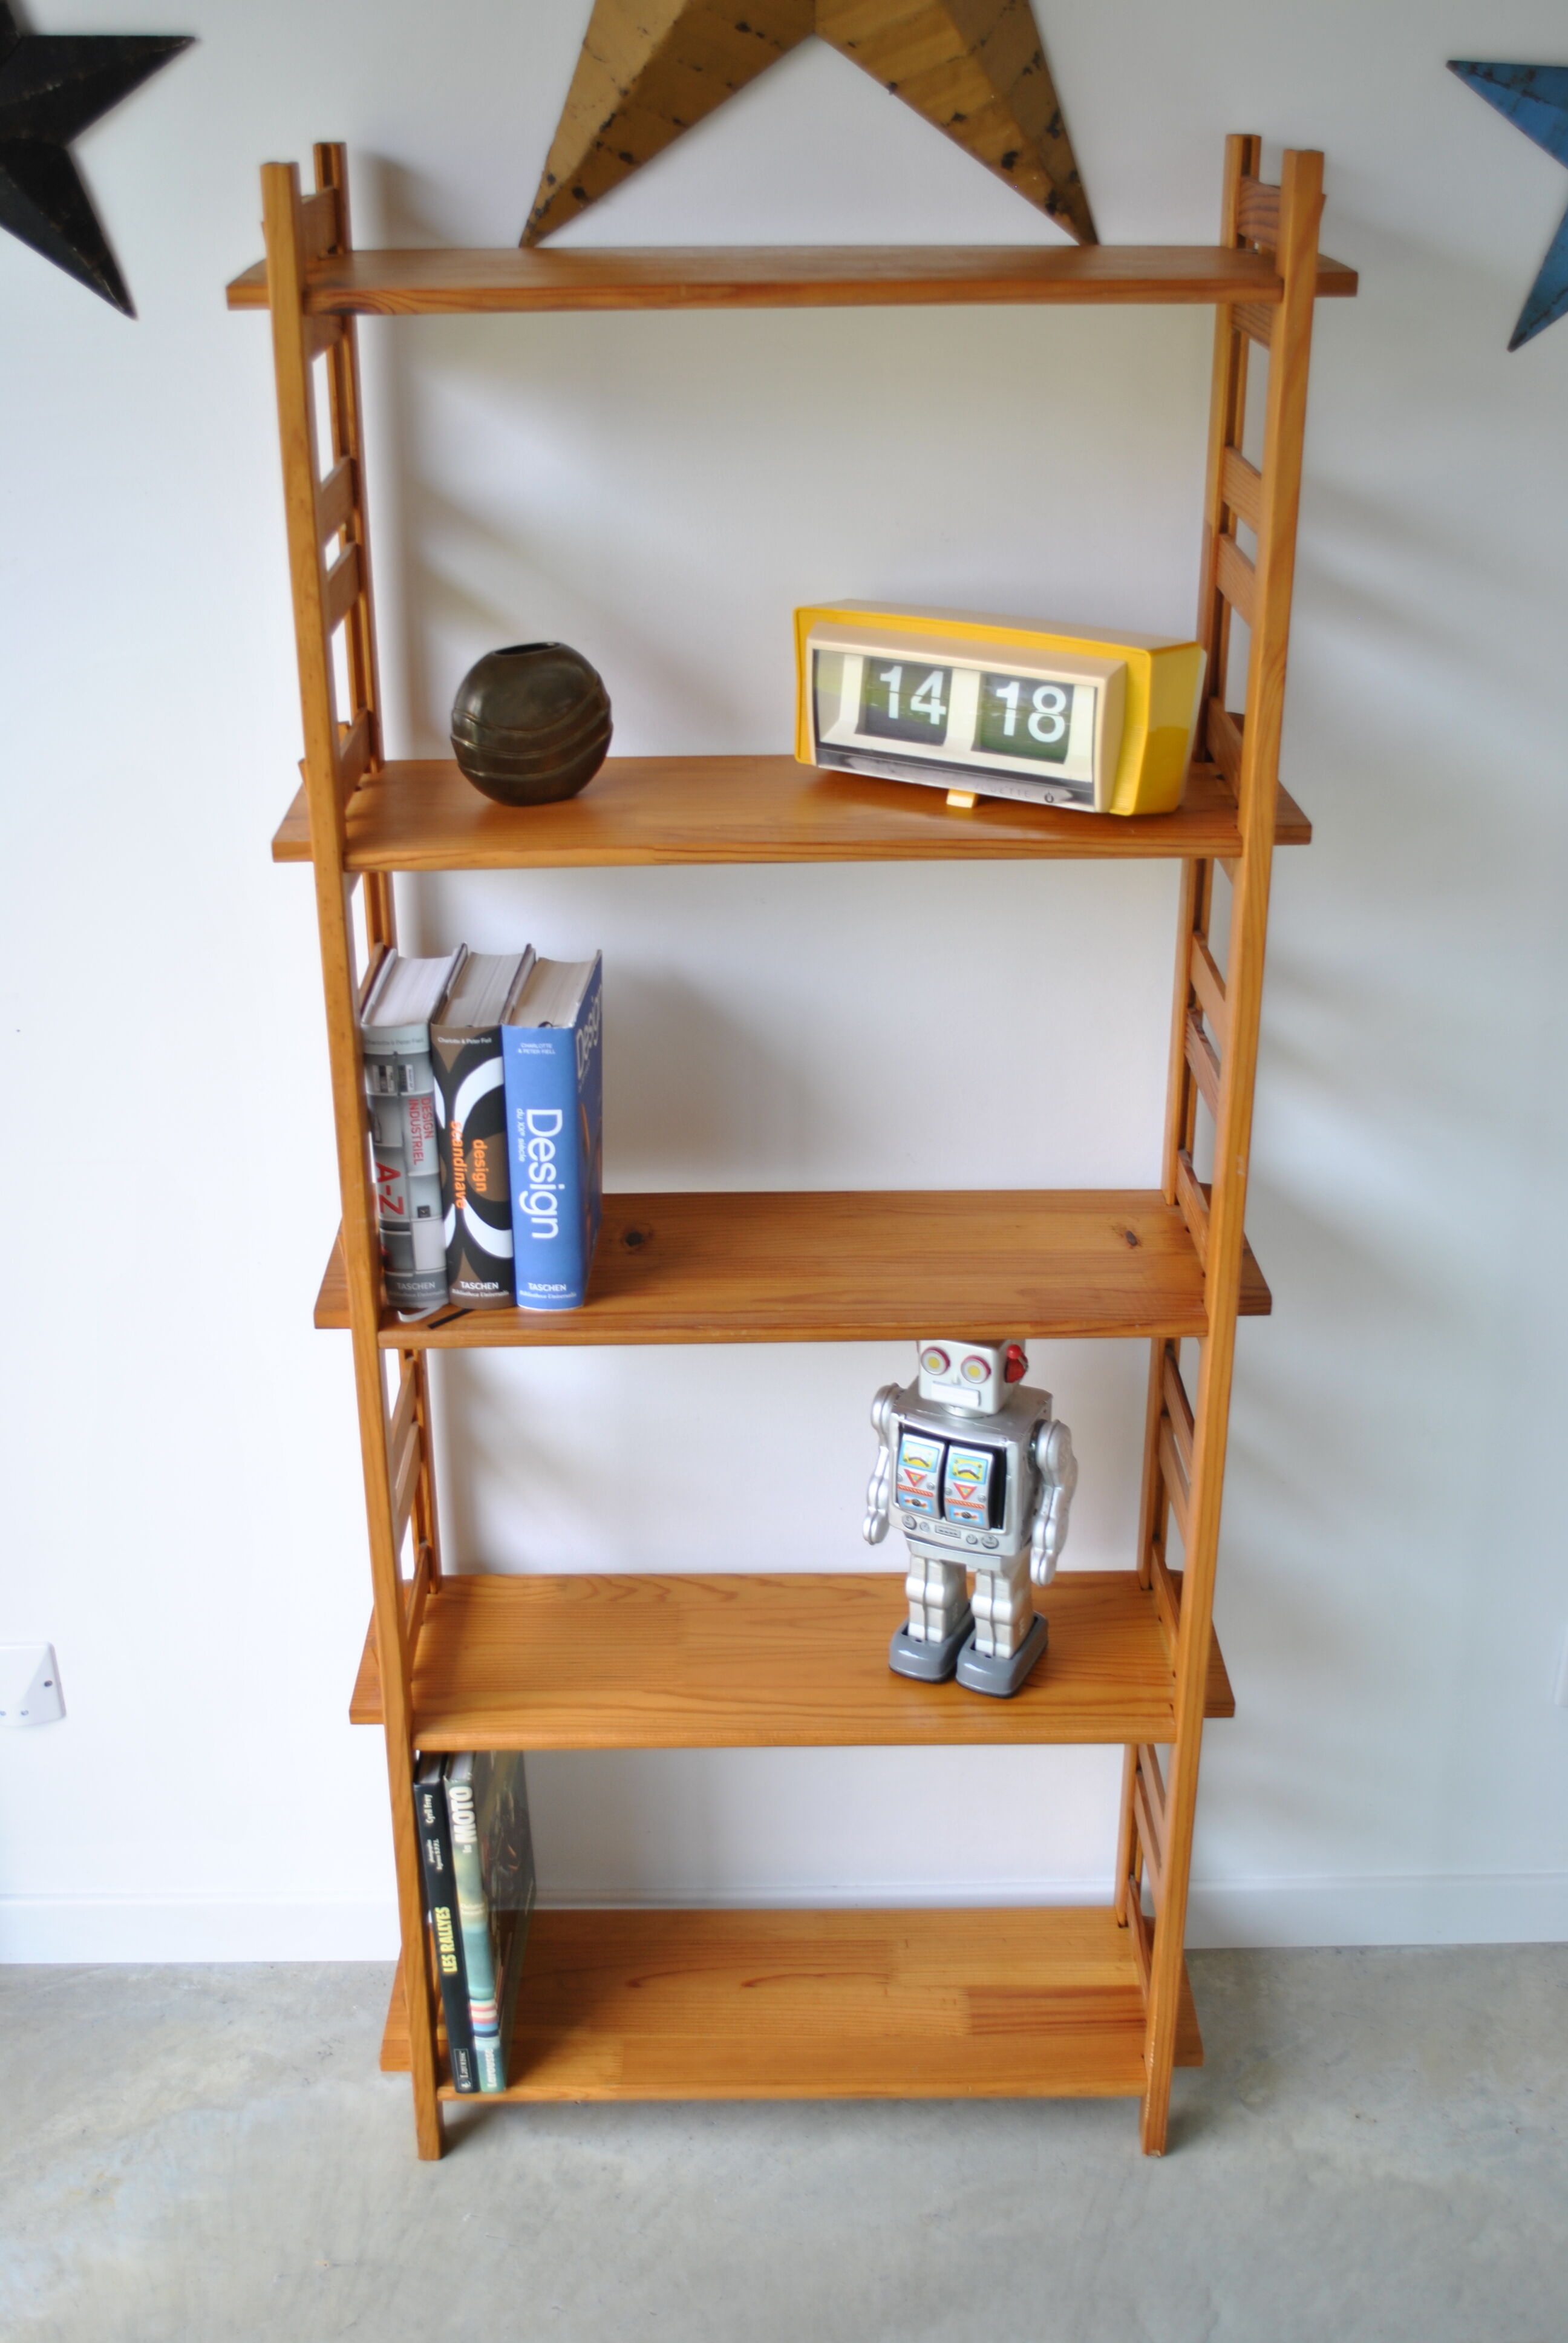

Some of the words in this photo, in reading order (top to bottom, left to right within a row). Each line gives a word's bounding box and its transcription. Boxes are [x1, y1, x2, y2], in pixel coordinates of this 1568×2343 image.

[880, 666, 946, 725] 14
[996, 681, 1067, 742] 18
[408, 1098, 425, 1165] INDUSTRIEL
[420, 1096, 434, 1140] DESIGN
[517, 1108, 525, 1119] du
[375, 1161, 404, 1215] A-Z
[450, 1119, 468, 1210] scandinave
[472, 1139, 489, 1192] design
[518, 1109, 565, 1239] Design
[397, 1281, 436, 1290] TASCHEN
[460, 1281, 499, 1290] TASCHEN
[528, 1282, 567, 1292] TASCHEN
[449, 1786, 477, 1843] MOTO
[434, 1906, 455, 1953] RALLYES
[441, 1953, 458, 1973] LES
